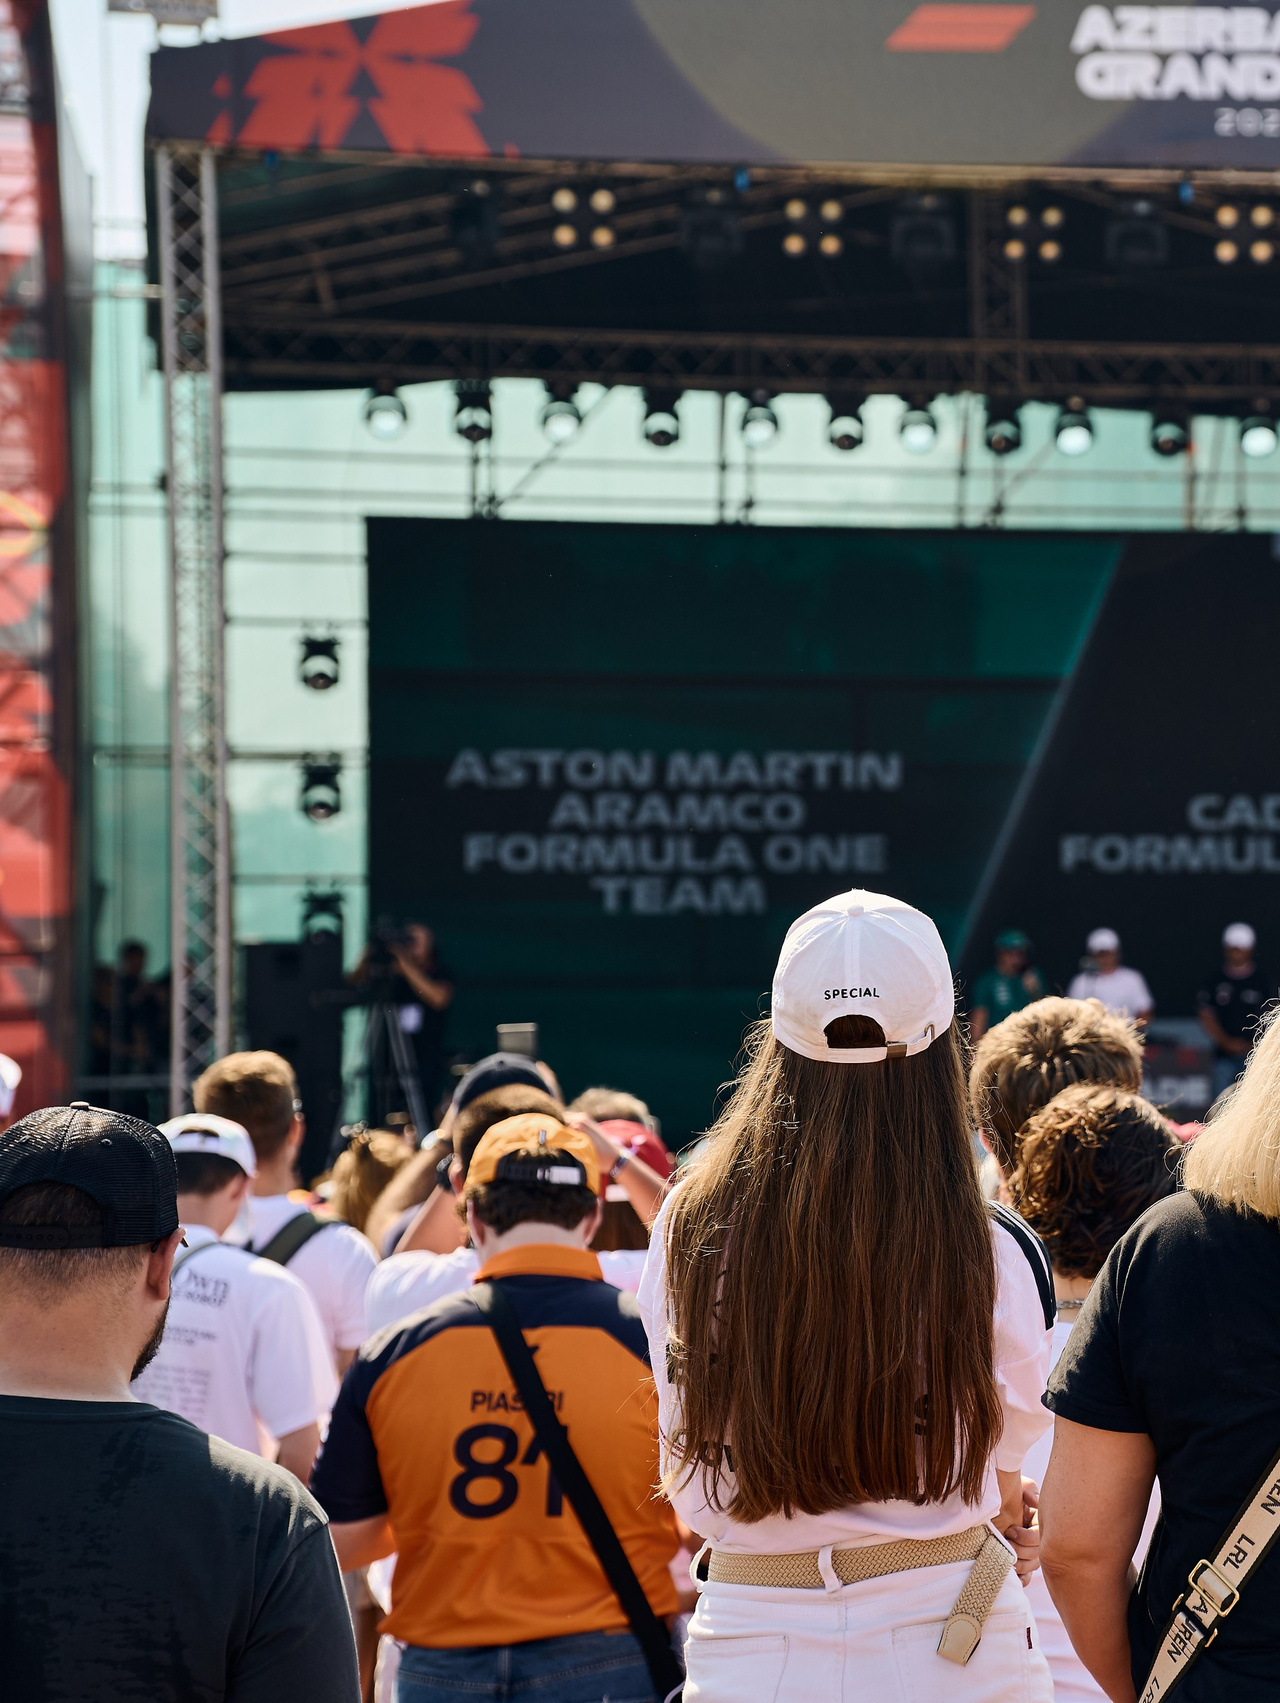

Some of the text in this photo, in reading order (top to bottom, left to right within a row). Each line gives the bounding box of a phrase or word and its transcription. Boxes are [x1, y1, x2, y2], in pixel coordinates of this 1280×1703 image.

[446, 749, 902, 791] ASTON MARTIN
[550, 793, 805, 831] ARAMCO
[463, 834, 887, 873] FORMULA ONE
[591, 876, 765, 915] TEAM
[824, 987, 880, 1000] SPECIAL
[470, 1390, 564, 1413] PIASI
[1222, 1533, 1256, 1570] LRL
[1167, 1596, 1209, 1663] AUREN
[1143, 1676, 1160, 1703] LR
